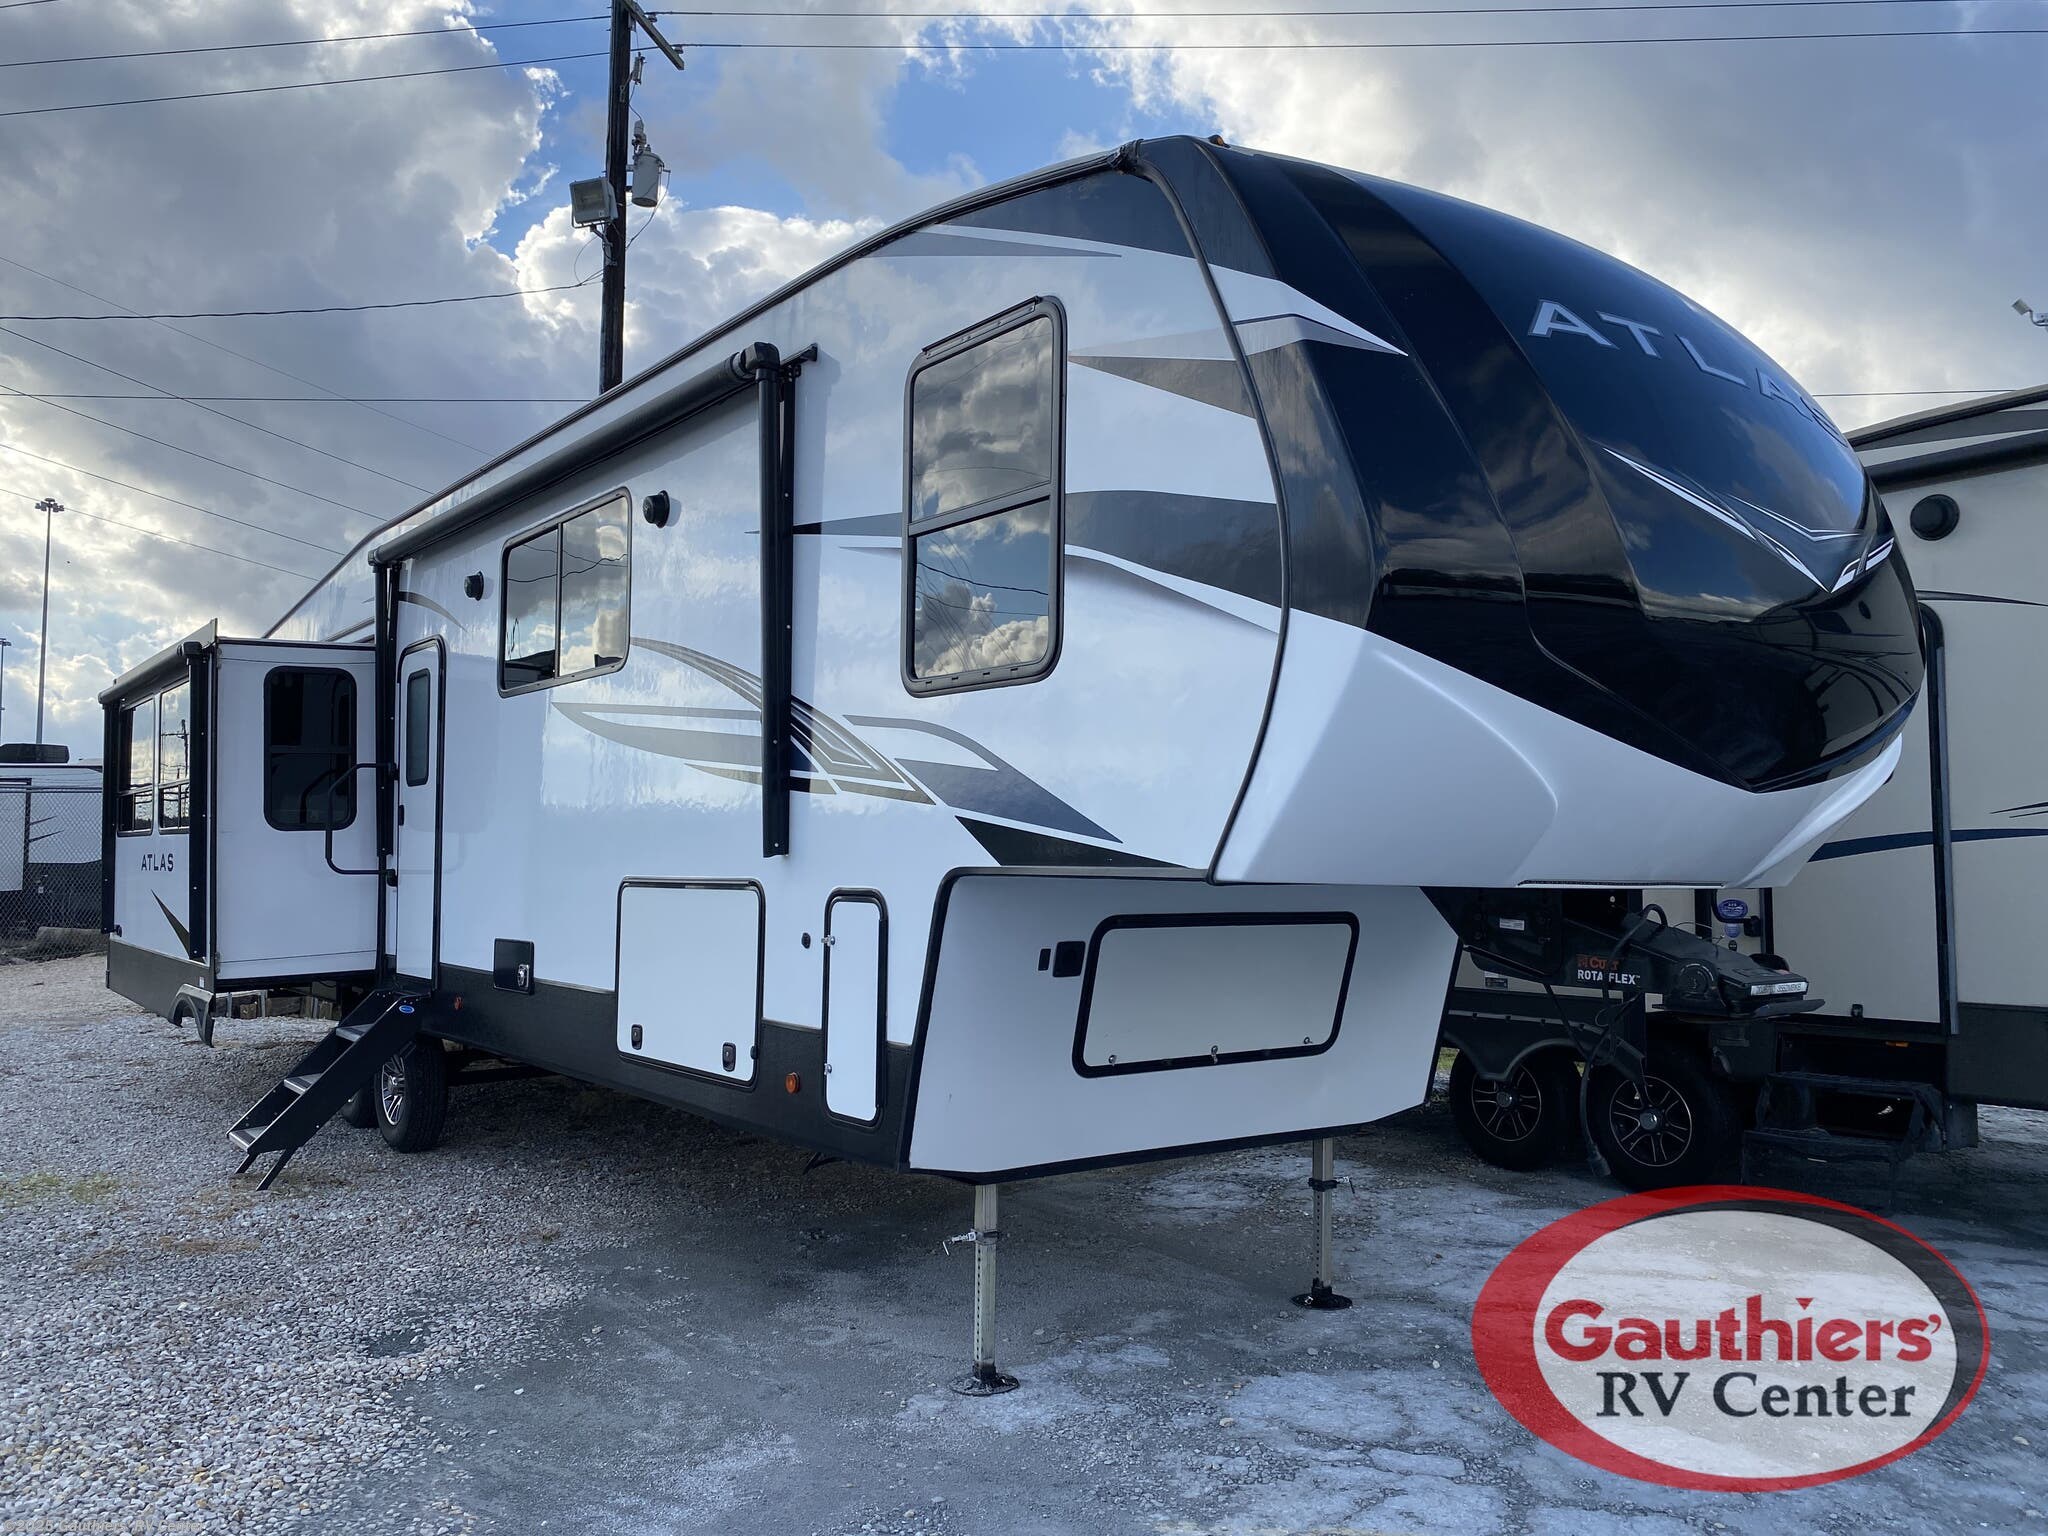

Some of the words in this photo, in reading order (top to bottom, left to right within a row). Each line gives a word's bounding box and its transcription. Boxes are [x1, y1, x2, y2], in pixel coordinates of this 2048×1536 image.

[1528, 299, 1848, 448] ATLAS
[140, 853, 174, 872] ATLAS
[1577, 969, 1603, 981] ROTA
